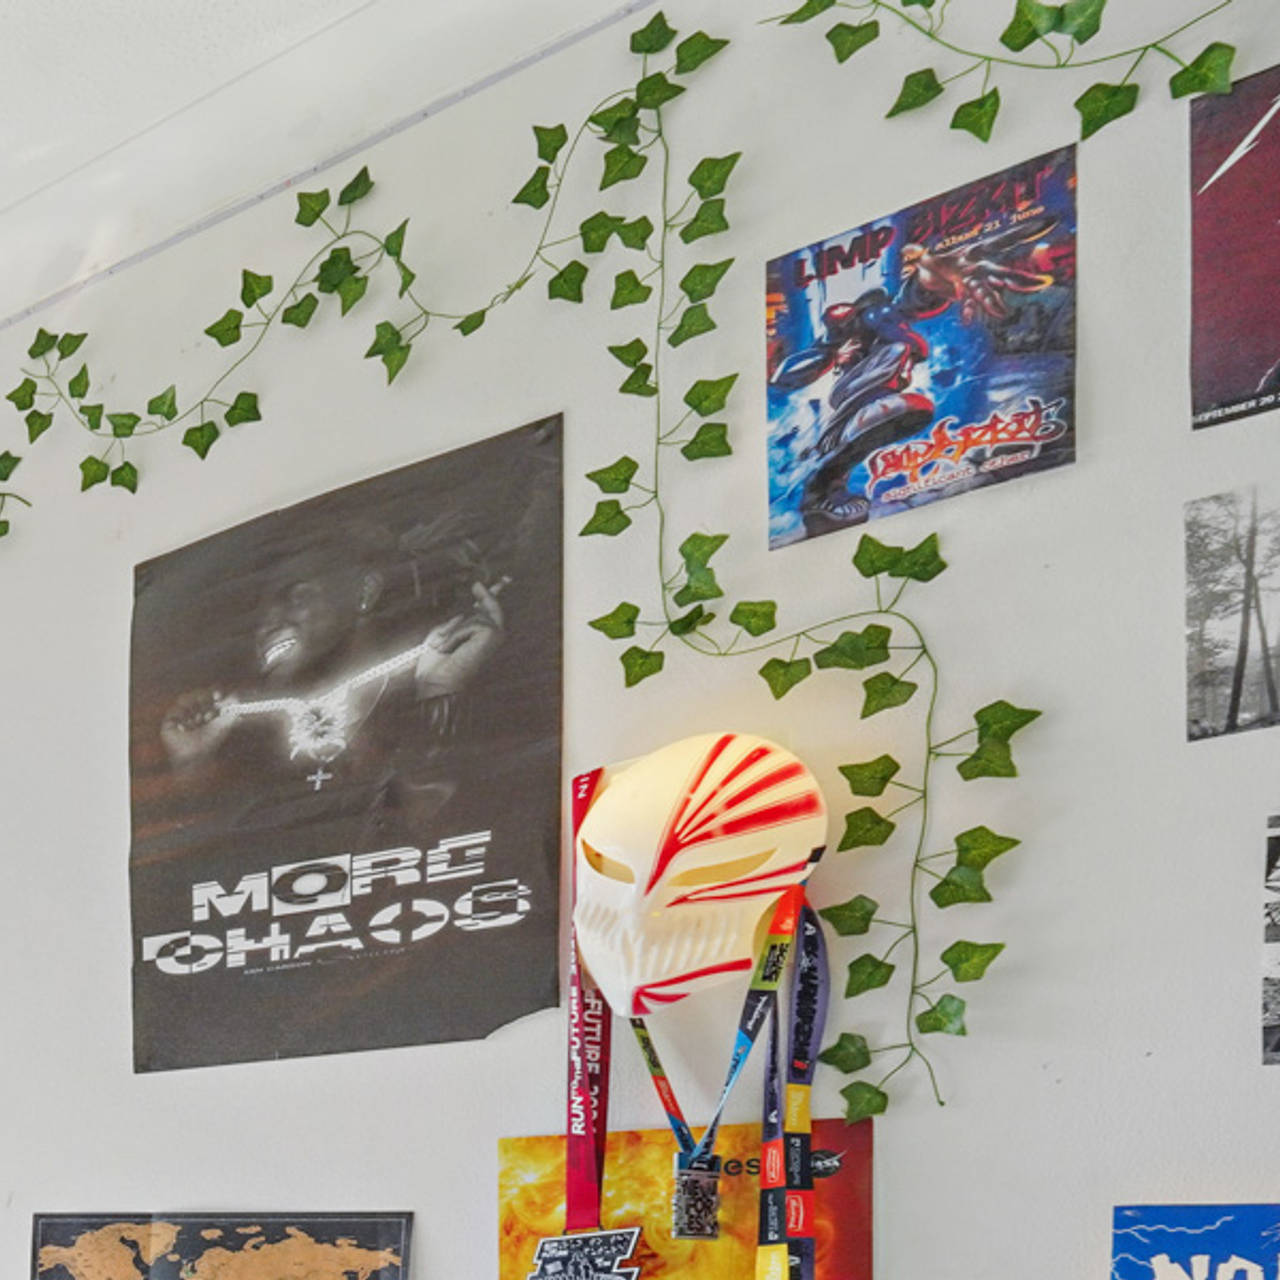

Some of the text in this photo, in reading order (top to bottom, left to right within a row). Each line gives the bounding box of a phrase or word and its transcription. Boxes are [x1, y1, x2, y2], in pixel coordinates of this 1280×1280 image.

[795, 225, 896, 287] LIMP
[192, 830, 492, 922] MORE
[142, 878, 532, 975] CHAOS
[571, 1096, 586, 1135] RUN
[723, 1158, 762, 1176] es
